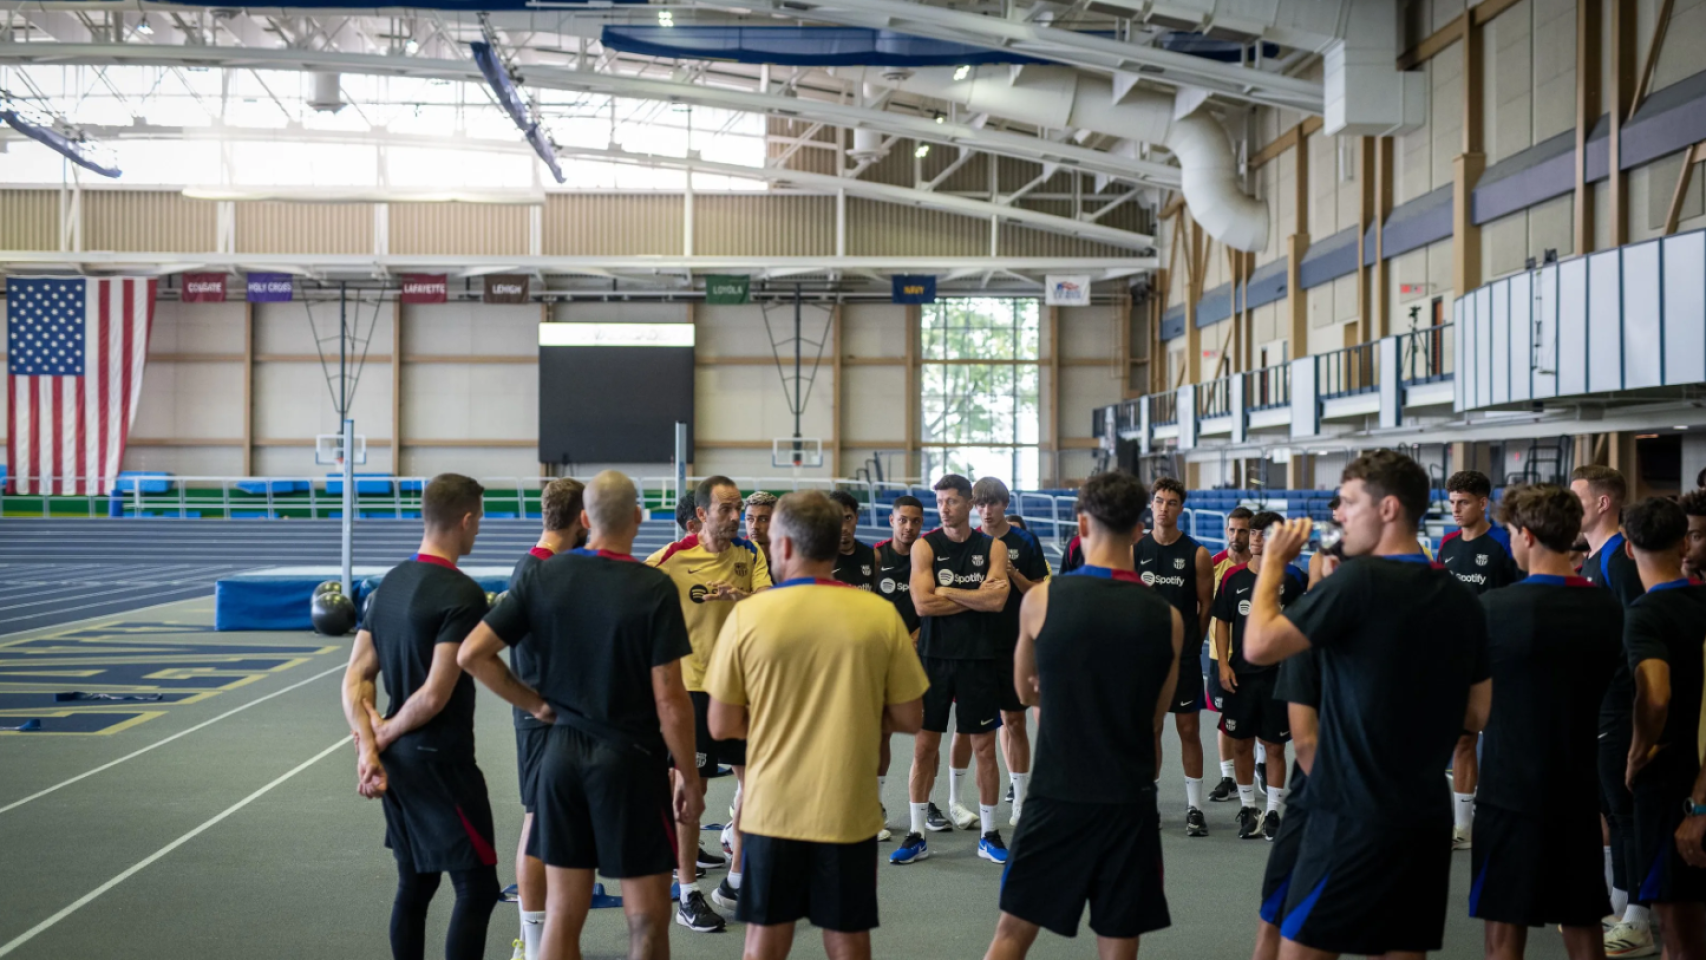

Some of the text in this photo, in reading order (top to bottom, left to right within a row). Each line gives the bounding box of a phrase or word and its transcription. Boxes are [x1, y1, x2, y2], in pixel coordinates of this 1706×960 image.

[248, 282, 292, 293] HOLY CROSS
[404, 284, 446, 294] LAFAYETTE
[492, 284, 522, 294] LEHIGH
[713, 285, 744, 295] LOYOLA
[903, 285, 924, 294] NAVY
[954, 571, 985, 584] Spotify
[1155, 574, 1185, 587] Spotify
